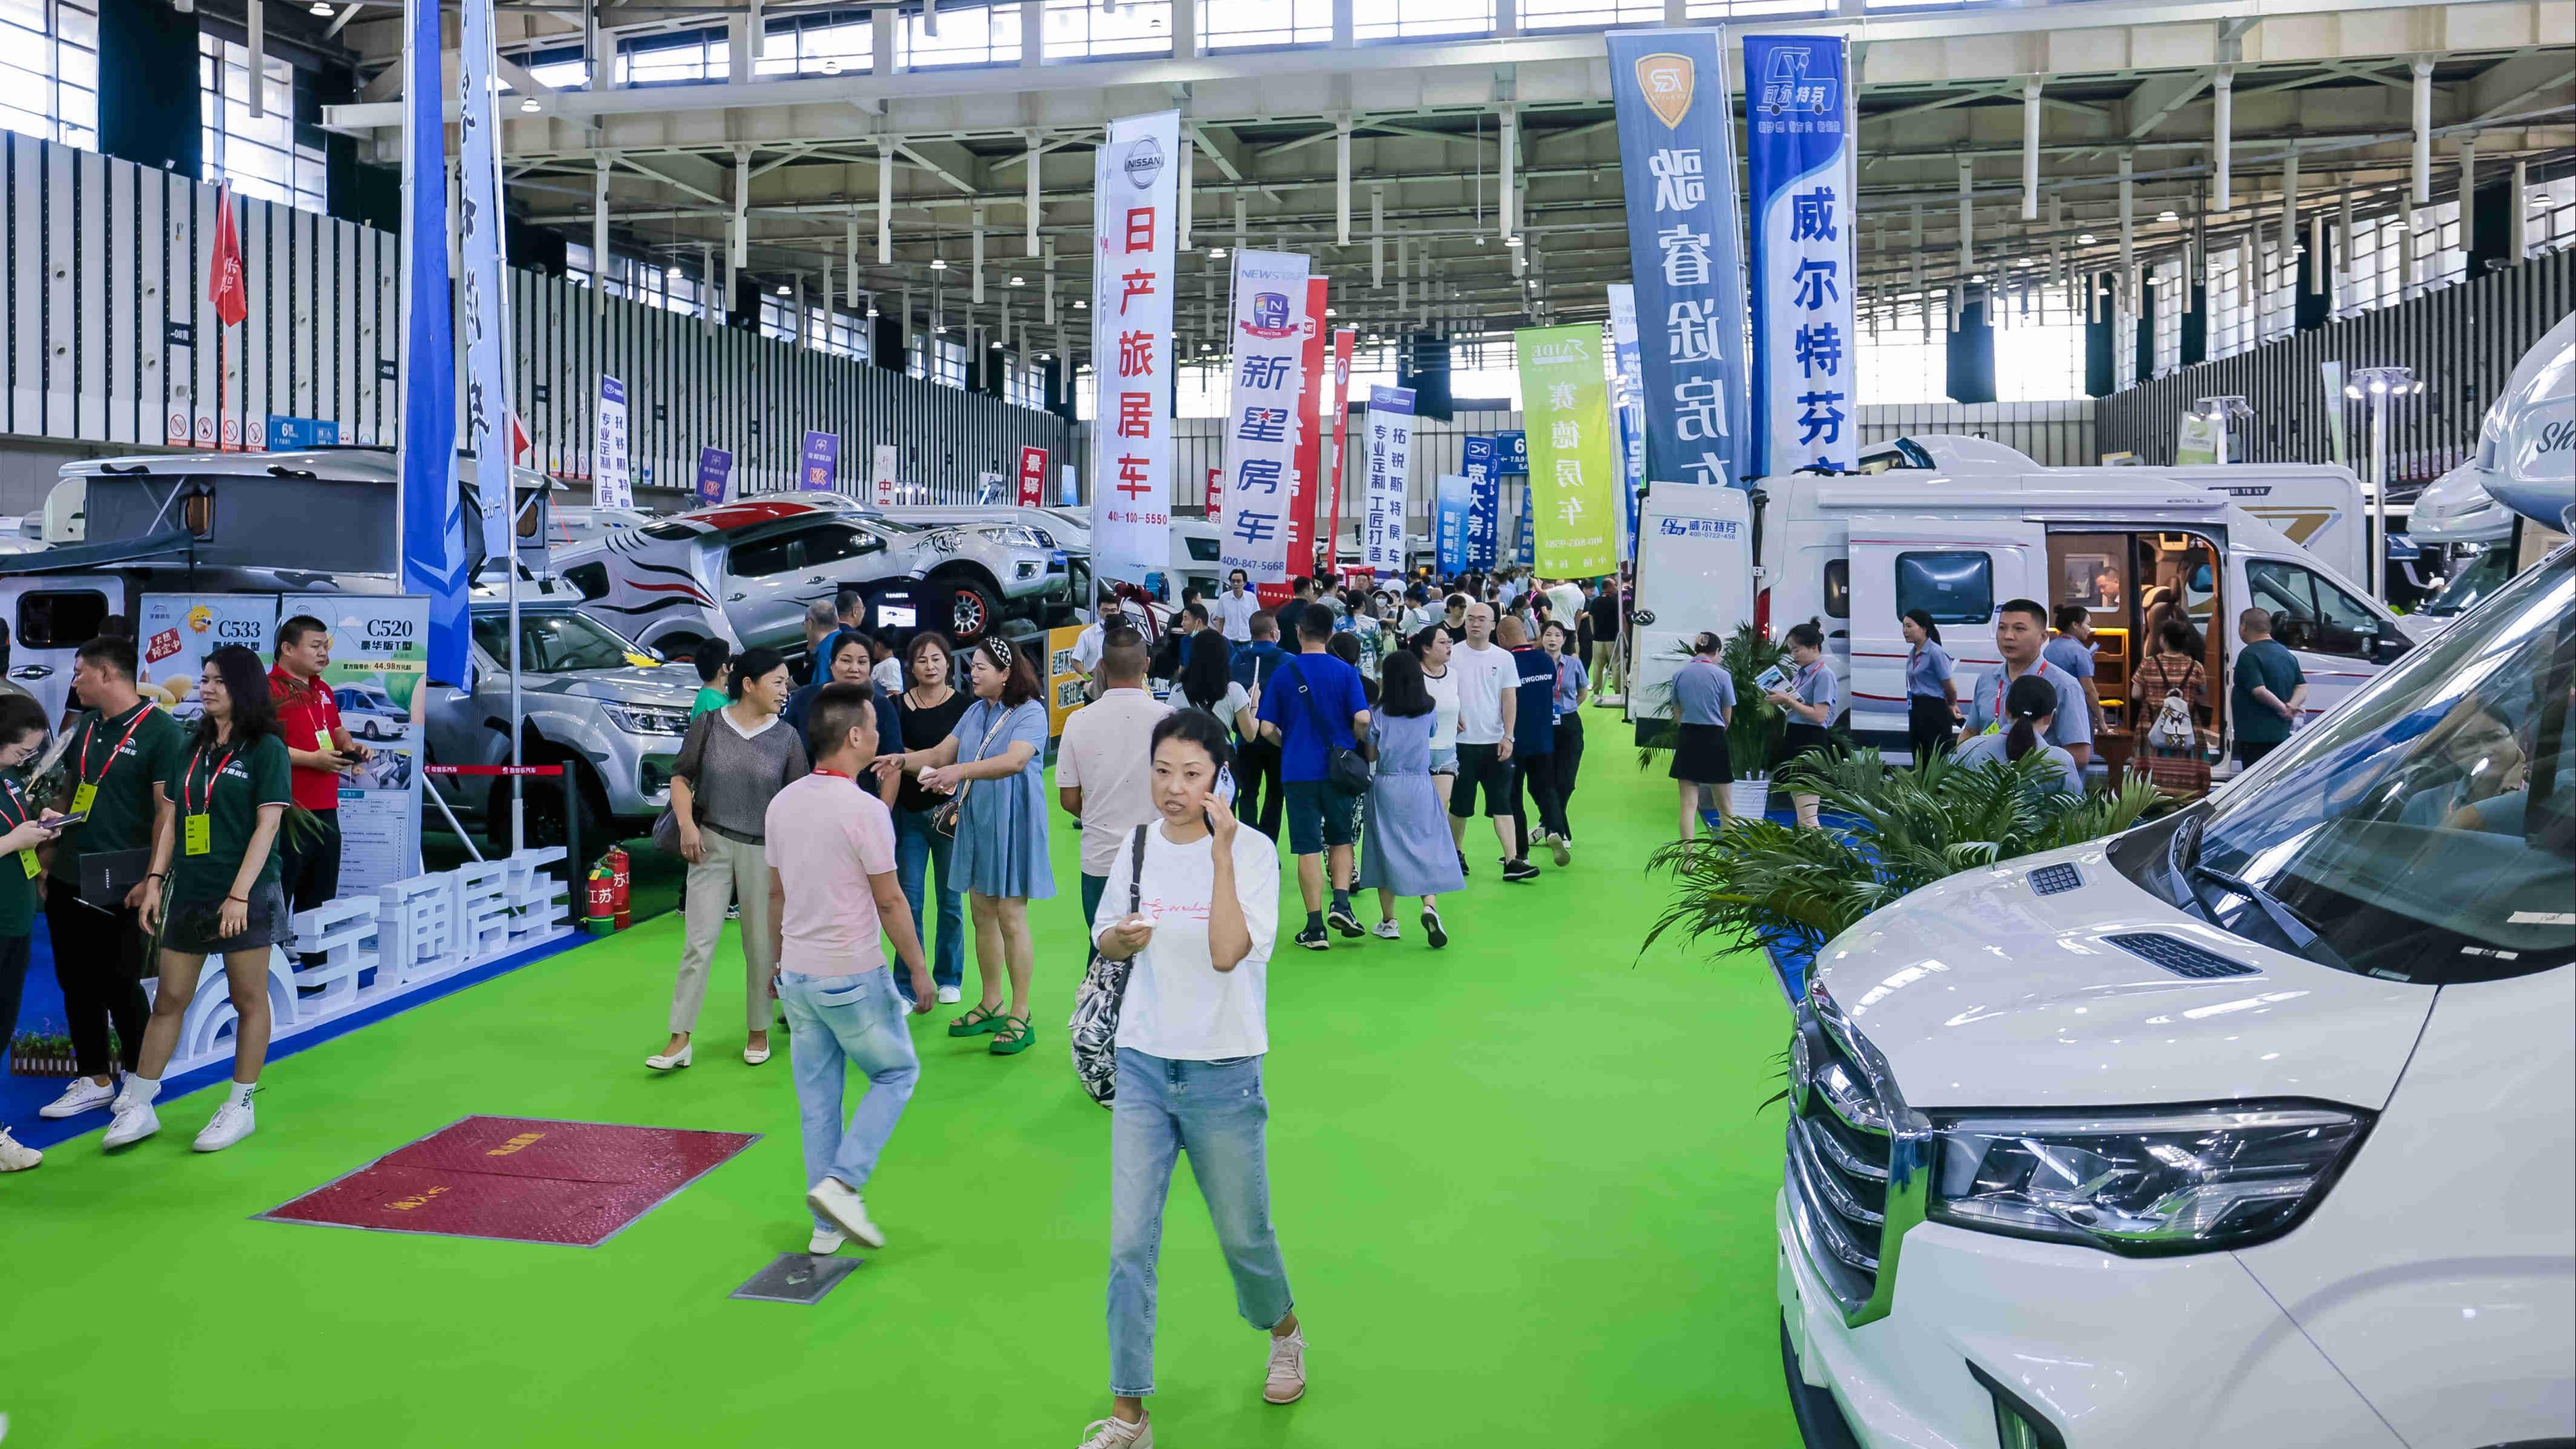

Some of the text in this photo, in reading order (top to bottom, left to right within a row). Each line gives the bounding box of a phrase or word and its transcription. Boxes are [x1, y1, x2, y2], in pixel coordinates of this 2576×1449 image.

[1128, 156, 1161, 168] NISSAN
[1116, 207, 1156, 501] 日产旅居车
[1233, 354, 1292, 545] 新星房车
[2536, 420, 2575, 453] Sh
[601, 475, 614, 507] 工匠
[1024, 454, 1042, 507] 景驿
[1369, 425, 1387, 562] 专业定制 工匠打造
[1389, 428, 1407, 564] 拓锐斯特房车
[1467, 463, 1488, 562] 宽大房车
[1689, 521, 1737, 533] 威尔特芬
[1221, 556, 1284, 571] 400-847-5668
[219, 620, 260, 637] C533
[367, 619, 412, 637] C520
[362, 640, 412, 651] 豪华版T型
[1521, 674, 1552, 684] EWGONOW
[294, 846, 569, 1015] 宇通房车
